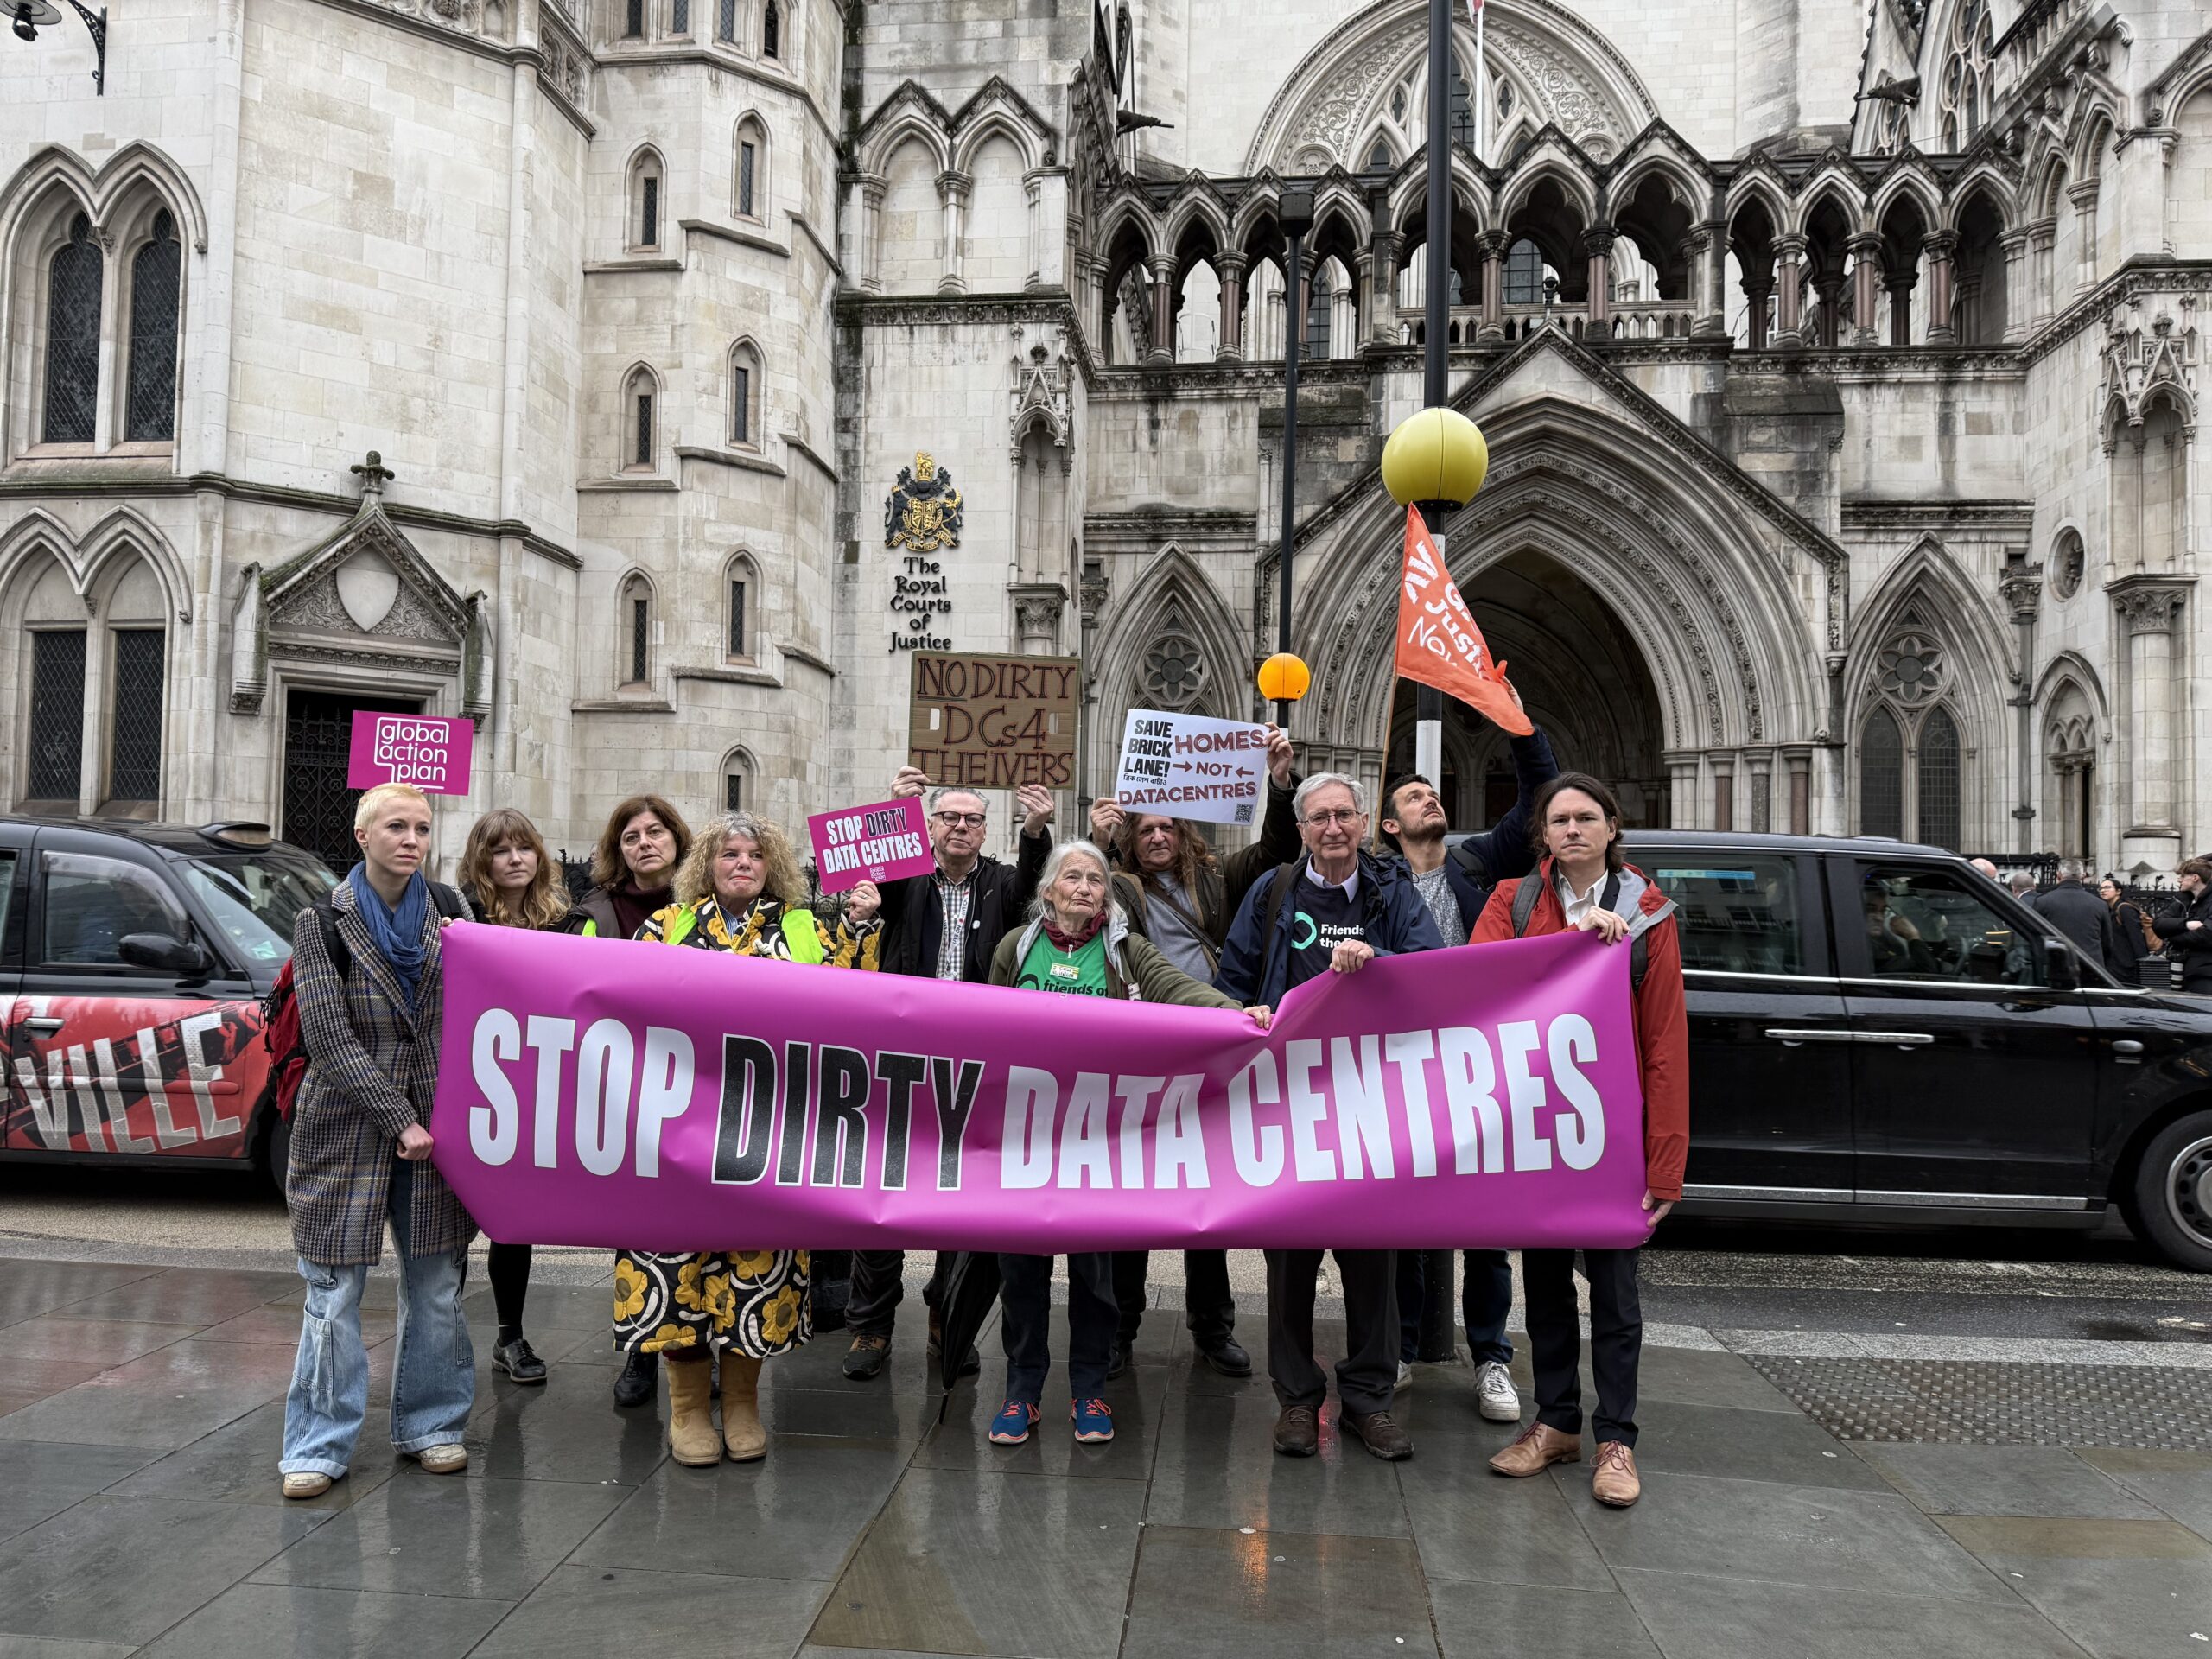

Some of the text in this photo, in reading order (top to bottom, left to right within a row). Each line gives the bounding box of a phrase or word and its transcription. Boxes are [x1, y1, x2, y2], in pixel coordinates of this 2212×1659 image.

[904, 557, 940, 574] The
[894, 575, 947, 595] Royal
[890, 594, 952, 612] Courts
[909, 613, 931, 630] of
[889, 632, 952, 652] Justice
[917, 658, 1076, 699] NO DIRTY
[380, 721, 448, 744] global
[1135, 719, 1173, 739] SAVE
[1128, 738, 1173, 758] BRICK
[1174, 729, 1265, 755] HOMES
[378, 743, 448, 764] action
[397, 761, 446, 782] plan
[1124, 757, 1170, 778] LANE!
[1196, 761, 1232, 777] NOT
[1119, 781, 1257, 806] DATACENTRES
[826, 807, 907, 845] STOP DIRTY
[823, 832, 923, 874] DATA CENTRES
[1320, 924, 1364, 936] Friends
[1319, 938, 1340, 948] the
[1044, 980, 1093, 995] friends
[469, 1008, 1605, 1191] STOP DIRTY DATA CENTRES
